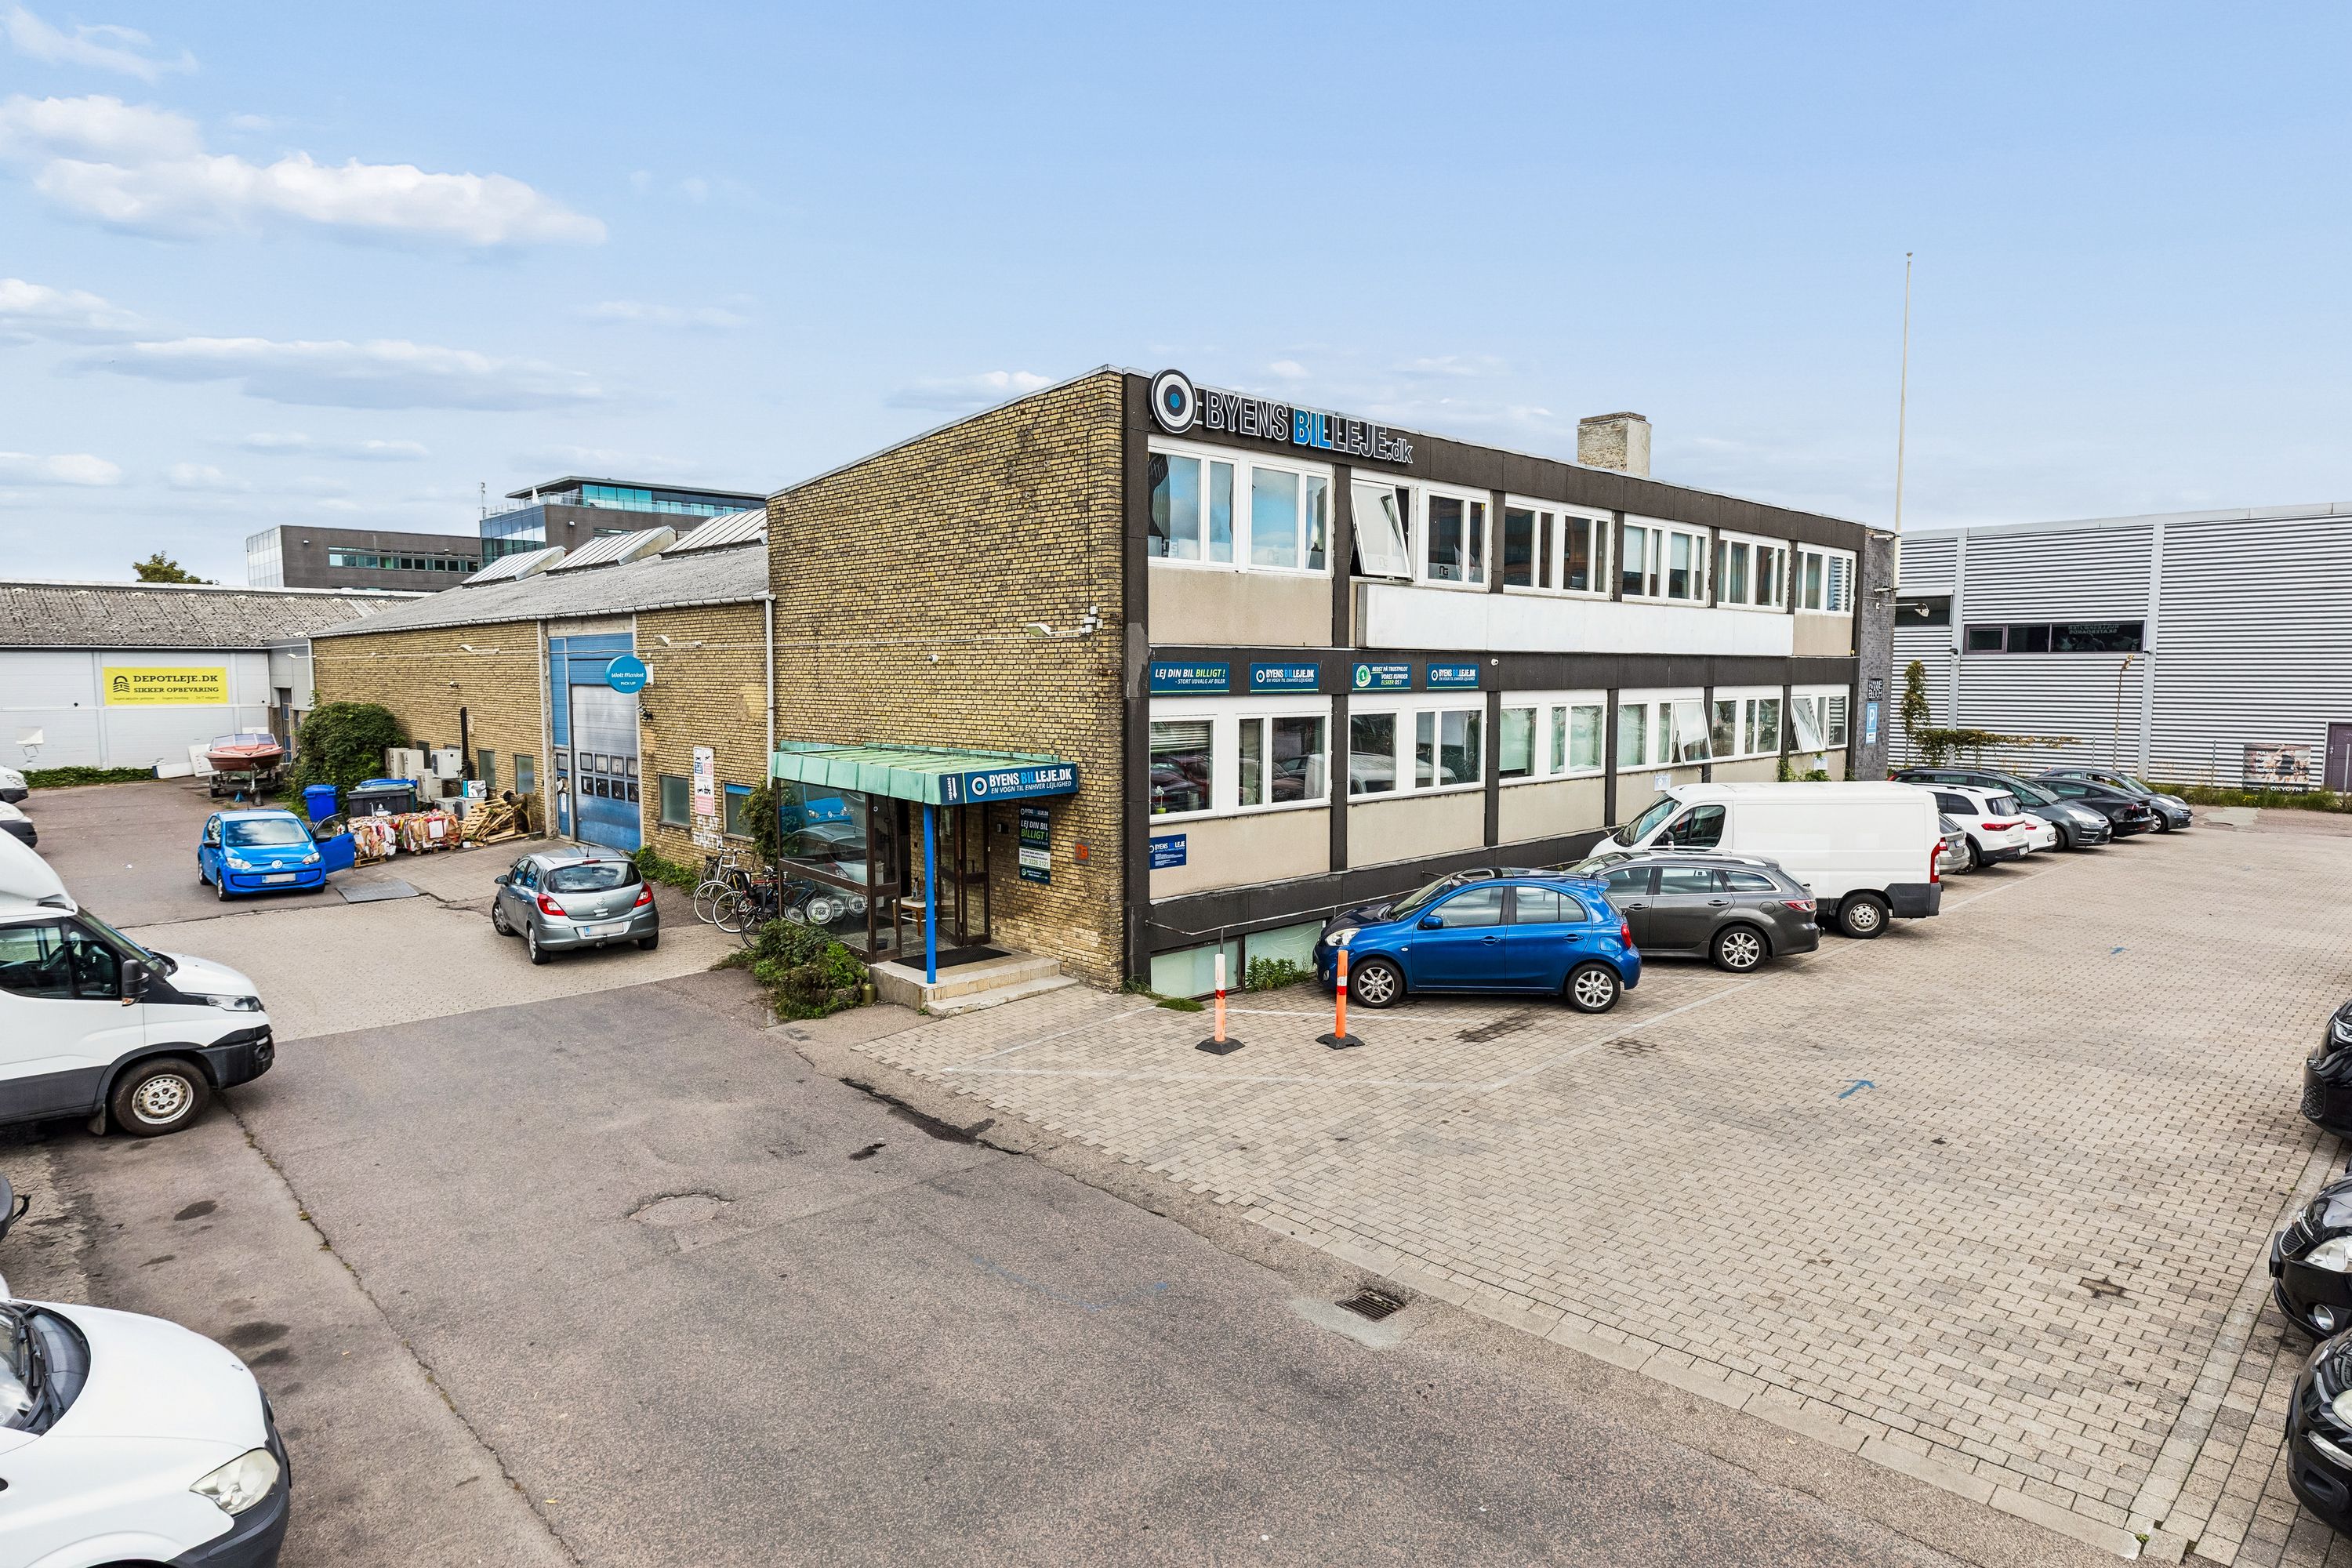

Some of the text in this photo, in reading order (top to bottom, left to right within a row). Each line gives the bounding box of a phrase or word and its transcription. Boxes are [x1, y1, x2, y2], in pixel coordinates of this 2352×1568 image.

[1205, 390, 1414, 464] BYENS BILLEJE.dk
[1155, 669, 1167, 680] LEJ
[1168, 669, 1181, 677] DIN
[1183, 669, 1194, 677] BIL
[1196, 669, 1221, 677] BILLIGT
[1266, 669, 1315, 678] BYENS BILLEJE.DK
[132, 675, 218, 684] DEPOTLEJE.DK
[1868, 689, 1882, 699] BLOCH
[1869, 709, 1875, 728] P
[989, 768, 1072, 788] BYENS BILLEJE.DK
[1046, 781, 1072, 790] LEJLIGHED
[1021, 828, 1045, 840] BILLIGT
